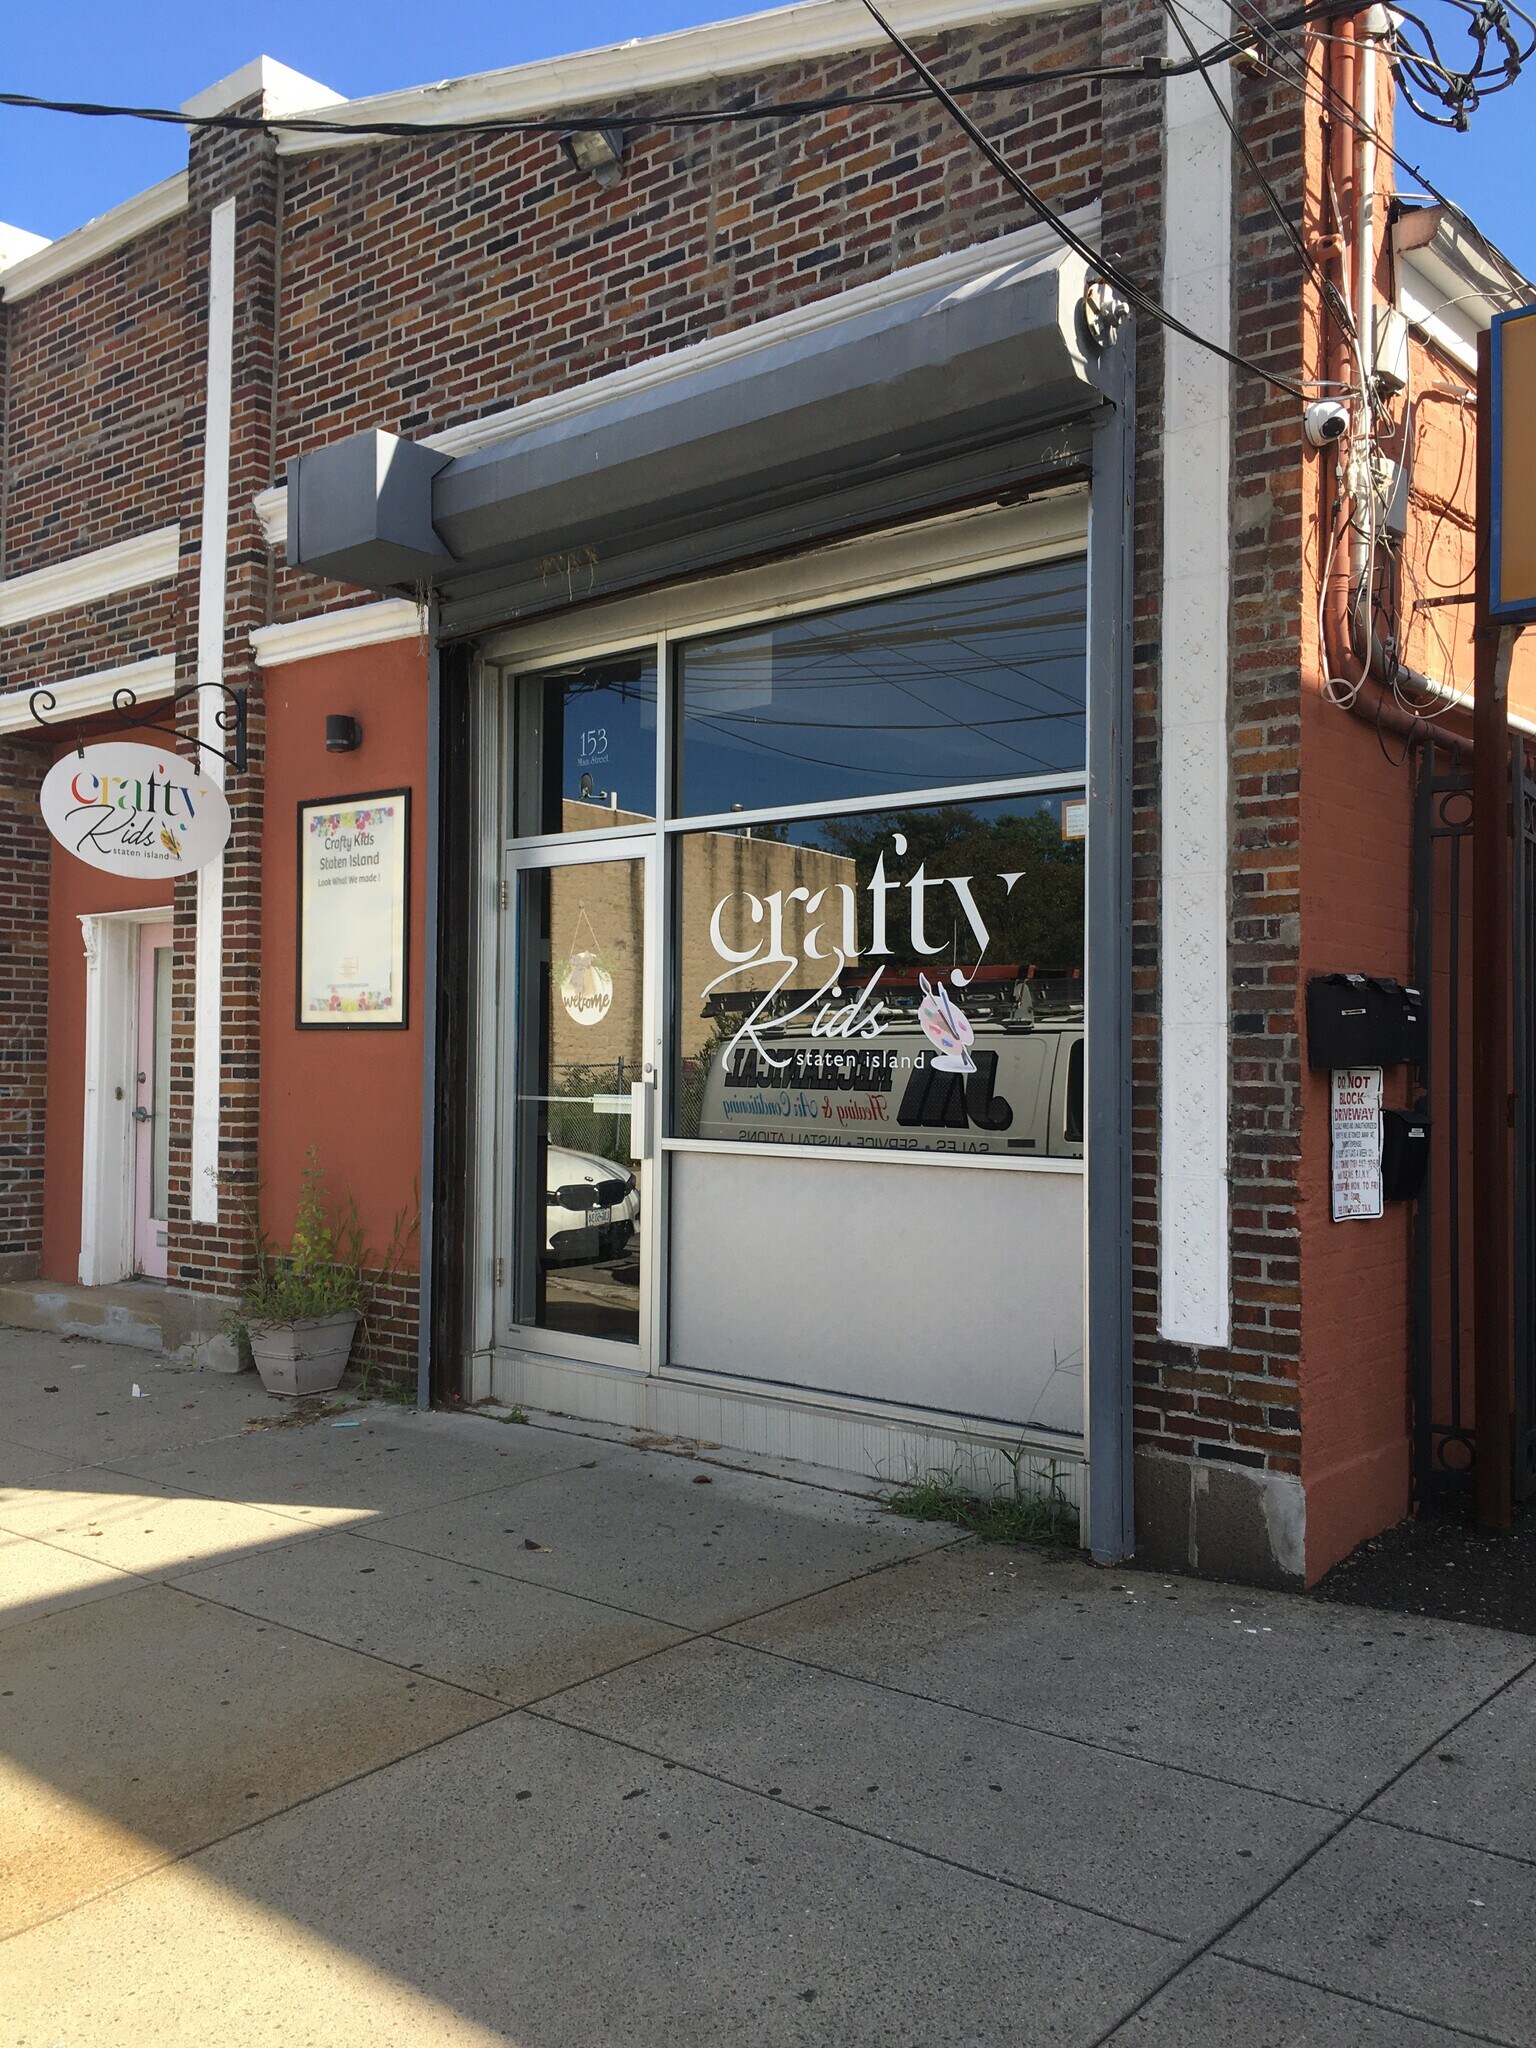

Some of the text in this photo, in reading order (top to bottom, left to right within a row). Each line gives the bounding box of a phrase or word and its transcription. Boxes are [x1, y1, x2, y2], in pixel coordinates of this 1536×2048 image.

[580, 728, 608, 757] 153
[71, 764, 207, 831] crafty
[65, 804, 155, 853] Kids
[324, 832, 375, 852] Crafty Kids
[113, 848, 170, 860] staten island
[320, 852, 380, 871] Staten Island
[359, 873, 377, 883] made
[710, 834, 1026, 987] crafty
[564, 992, 611, 1012] welcome
[701, 946, 890, 1072] Kids
[796, 1051, 925, 1069] staten island
[1337, 1075, 1371, 1089] DO NOT
[1339, 1092, 1365, 1105] BLOCK
[1335, 1107, 1374, 1121] DRIVEWAY
